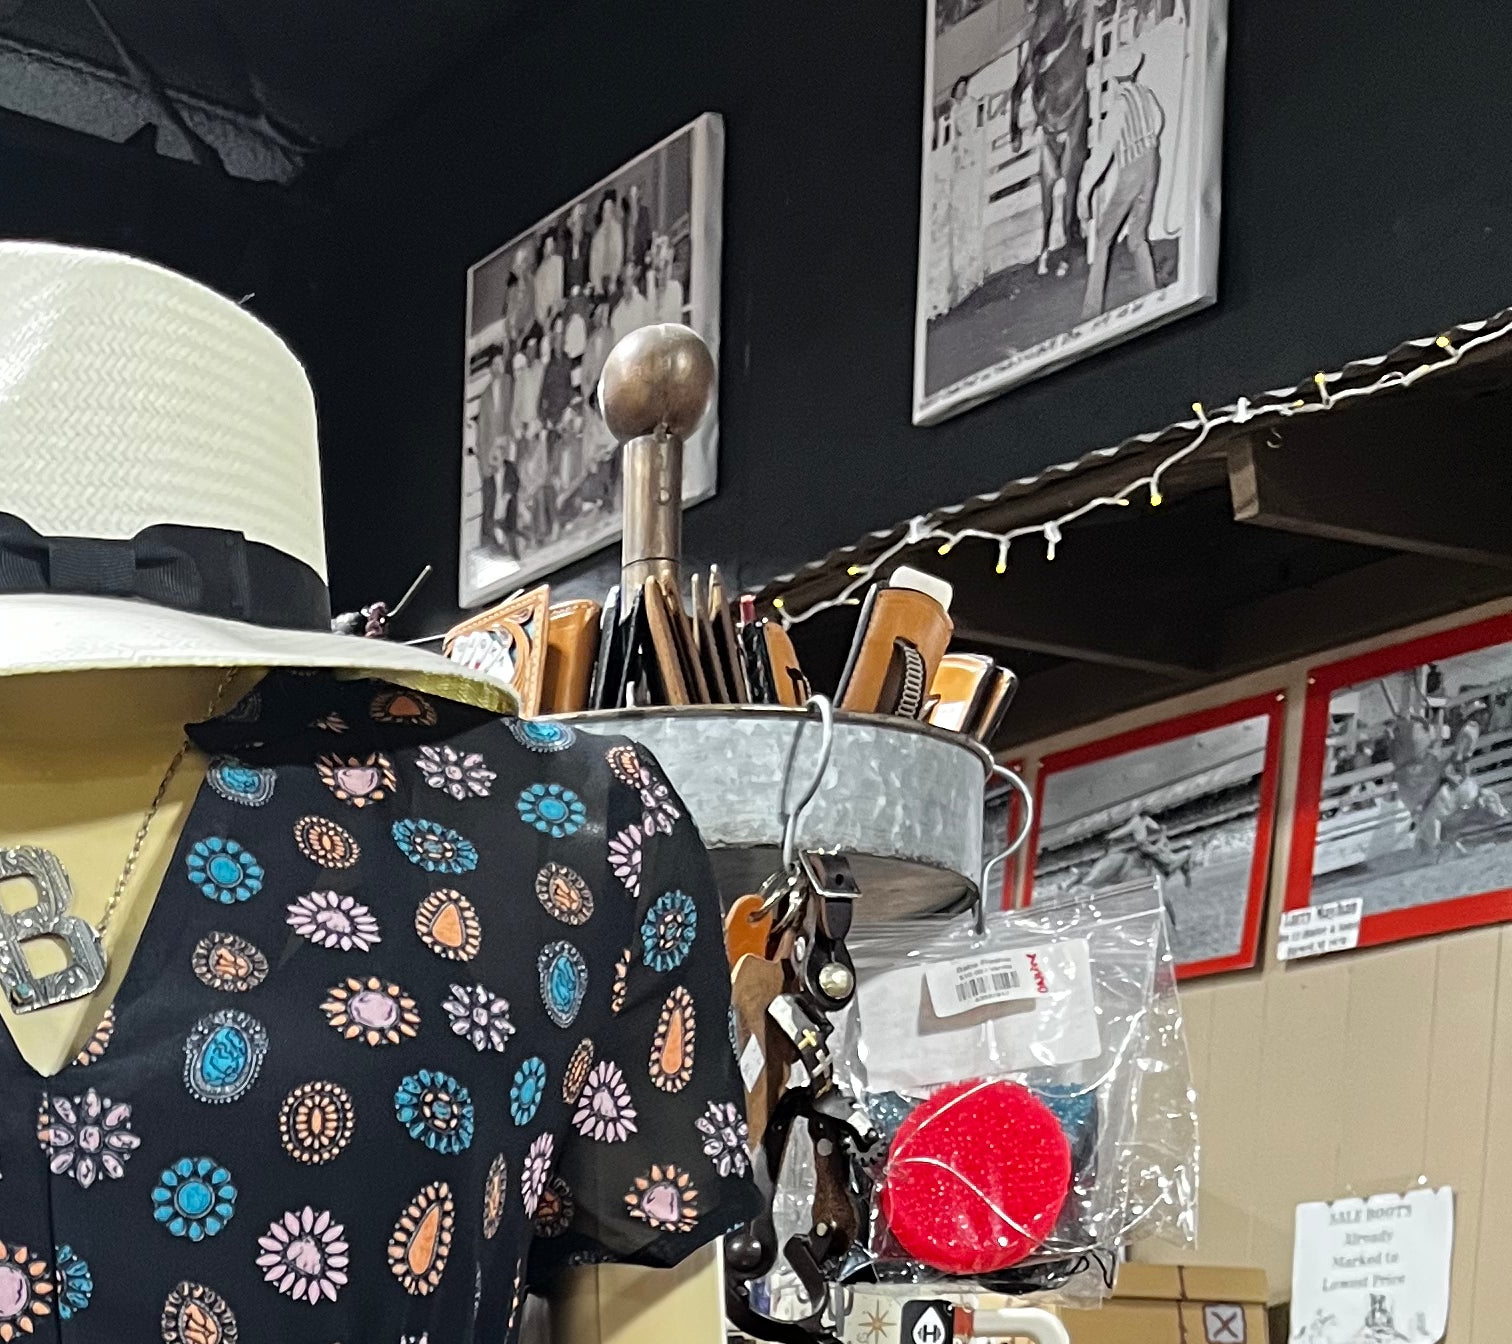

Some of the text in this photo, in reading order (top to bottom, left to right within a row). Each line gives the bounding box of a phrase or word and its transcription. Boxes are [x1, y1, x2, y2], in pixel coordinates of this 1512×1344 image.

[1366, 1204, 1413, 1222] BOOTS
[1344, 1229, 1394, 1246] Already
[1332, 1252, 1382, 1269] Marked
